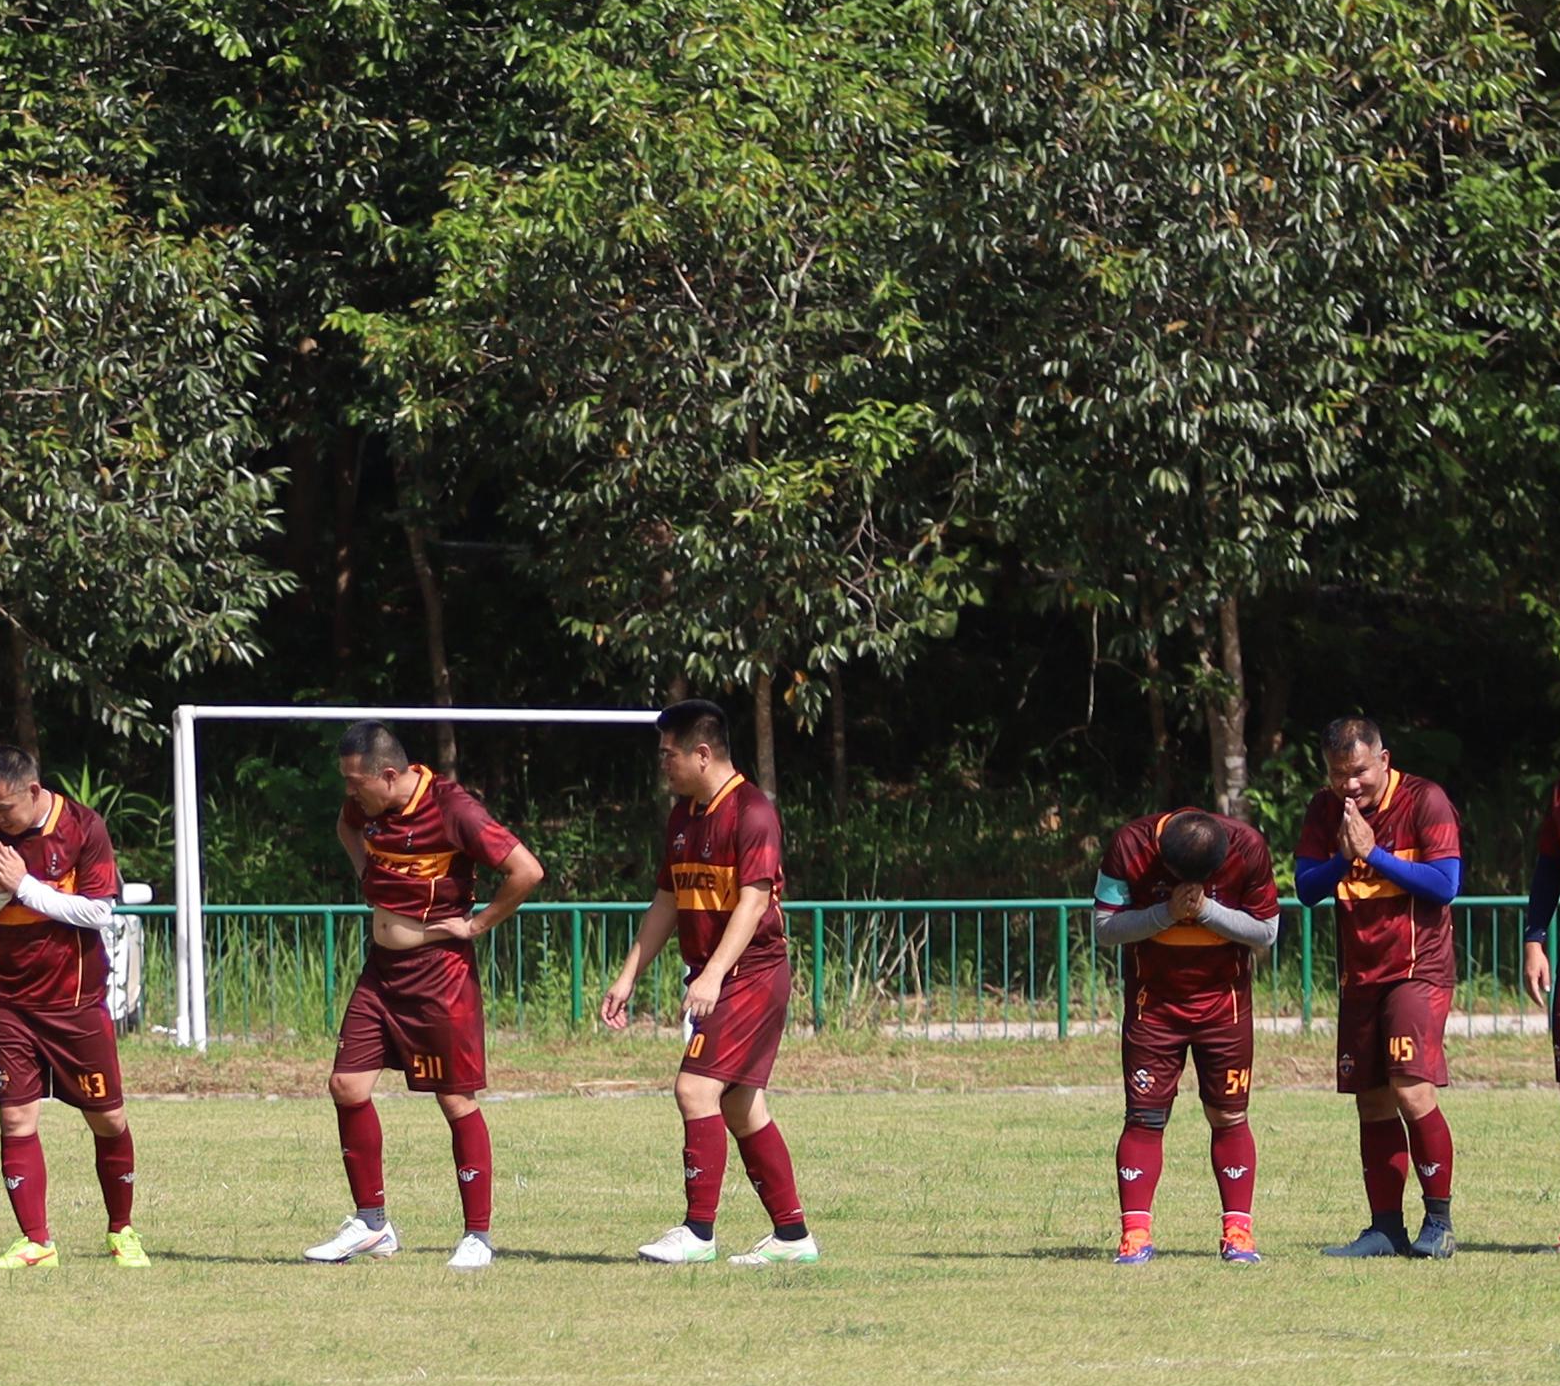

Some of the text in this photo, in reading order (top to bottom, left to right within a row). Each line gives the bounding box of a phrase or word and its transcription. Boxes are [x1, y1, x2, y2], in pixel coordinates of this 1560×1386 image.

[688, 1033, 706, 1059] 0
[1389, 1036, 1413, 1062] 45
[1225, 1068, 1250, 1095] 54
